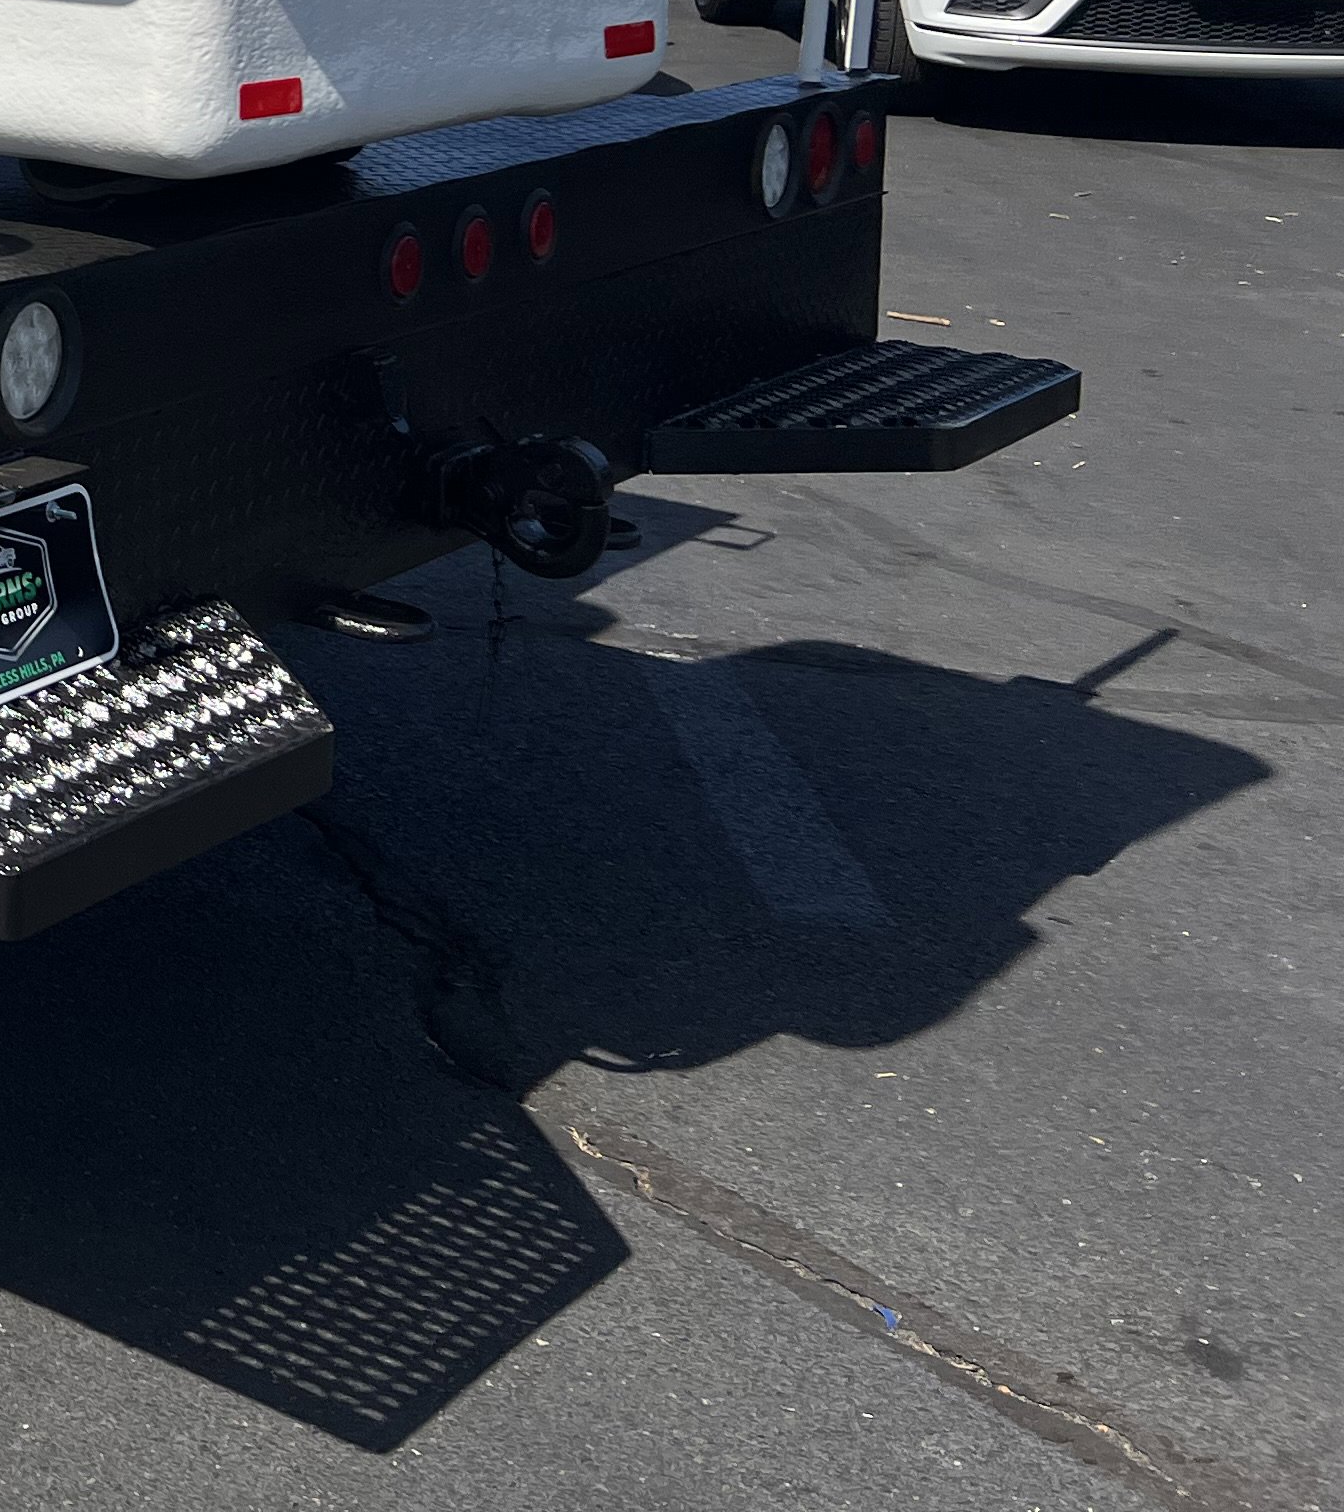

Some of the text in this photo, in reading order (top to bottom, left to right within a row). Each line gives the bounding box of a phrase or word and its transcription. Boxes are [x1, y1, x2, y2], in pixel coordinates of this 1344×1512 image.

[0, 602, 39, 625] GROUP
[18, 657, 53, 679] HILLS,
[50, 650, 66, 668] PA
